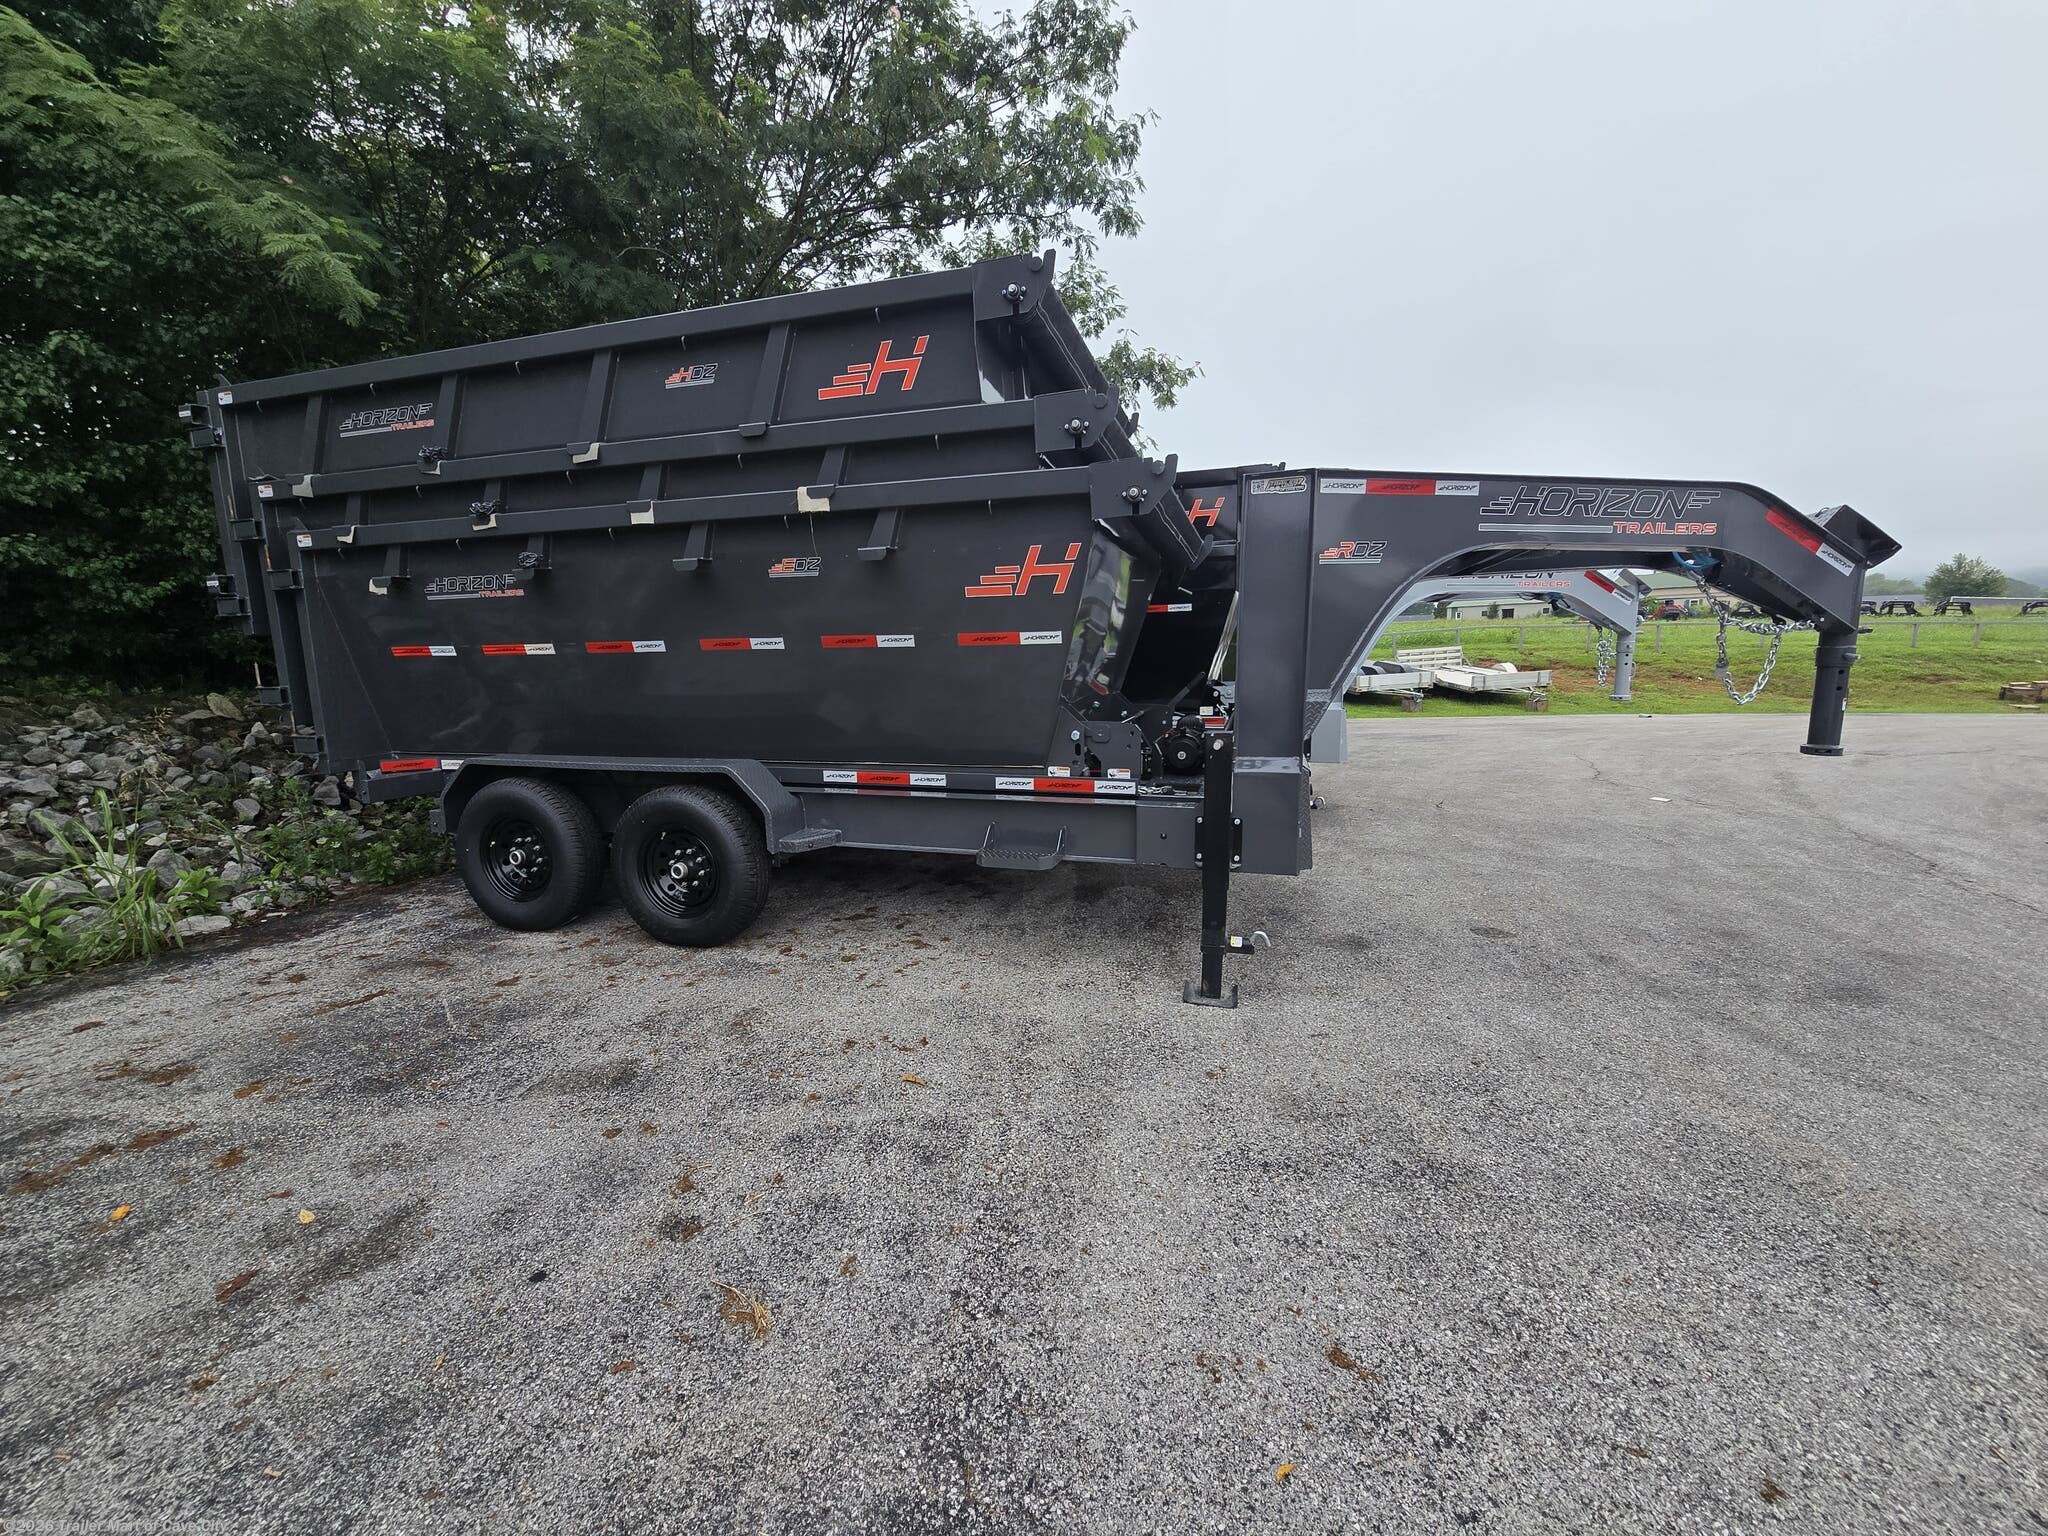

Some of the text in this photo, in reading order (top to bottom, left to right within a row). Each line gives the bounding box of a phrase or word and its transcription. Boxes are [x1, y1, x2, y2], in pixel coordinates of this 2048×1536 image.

[339, 403, 432, 430] HORIZON
[1480, 486, 1721, 519] HORIZON
[1613, 521, 1718, 536] TRAILERS
[424, 574, 516, 593] HORIZON
